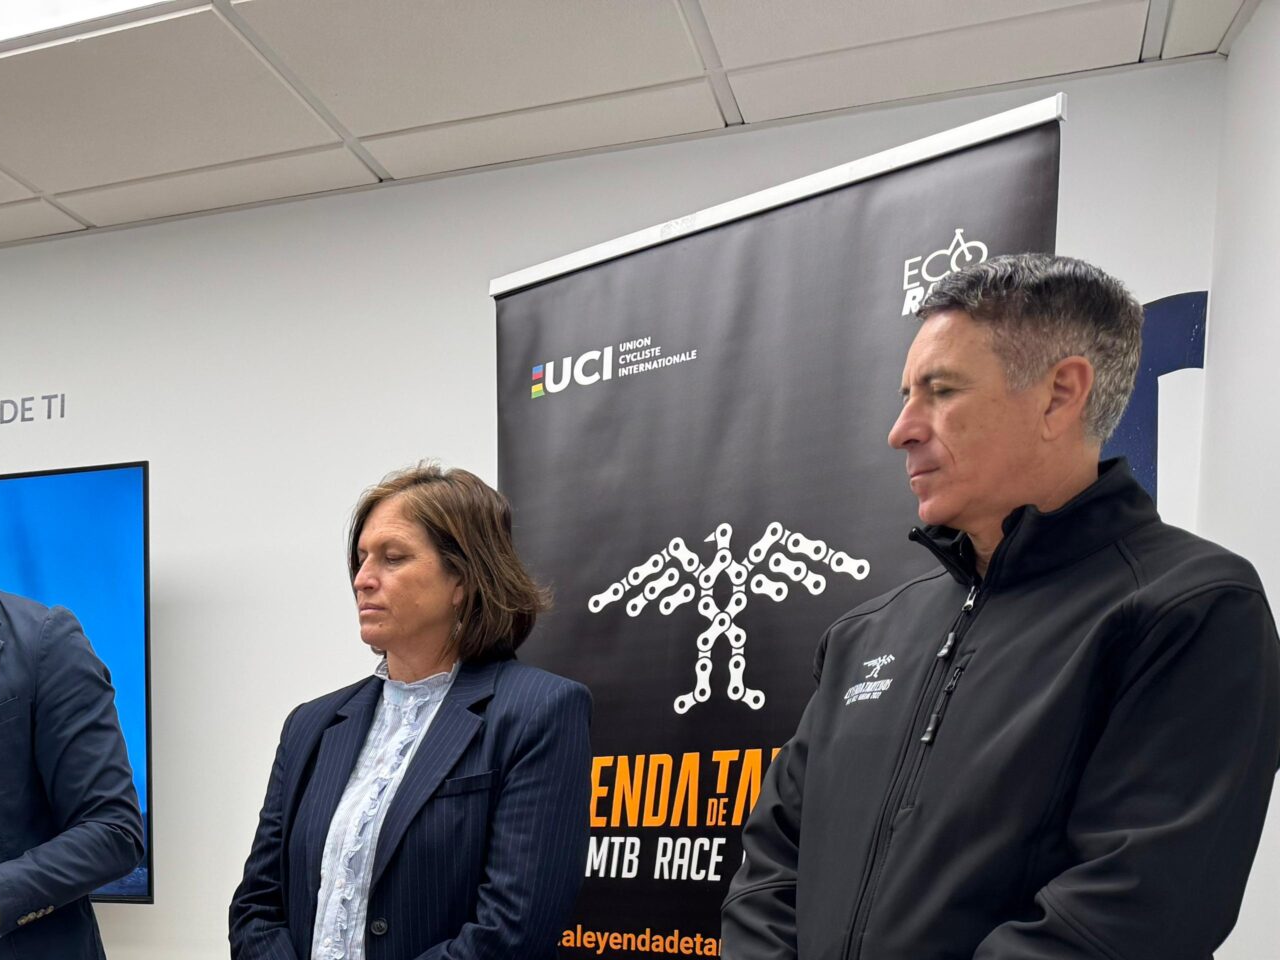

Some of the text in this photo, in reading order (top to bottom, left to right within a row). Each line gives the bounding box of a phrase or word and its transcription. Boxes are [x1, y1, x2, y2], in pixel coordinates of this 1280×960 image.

[619, 336, 652, 352] UNION
[619, 346, 662, 365] CYCLISTE
[544, 345, 613, 393] UCI
[618, 349, 698, 377] INTERNATIONALE
[0, 396, 35, 425] DE
[41, 393, 66, 420] TI
[711, 747, 782, 826] TA
[706, 797, 729, 827] DE
[584, 836, 726, 881] MTB RACE
